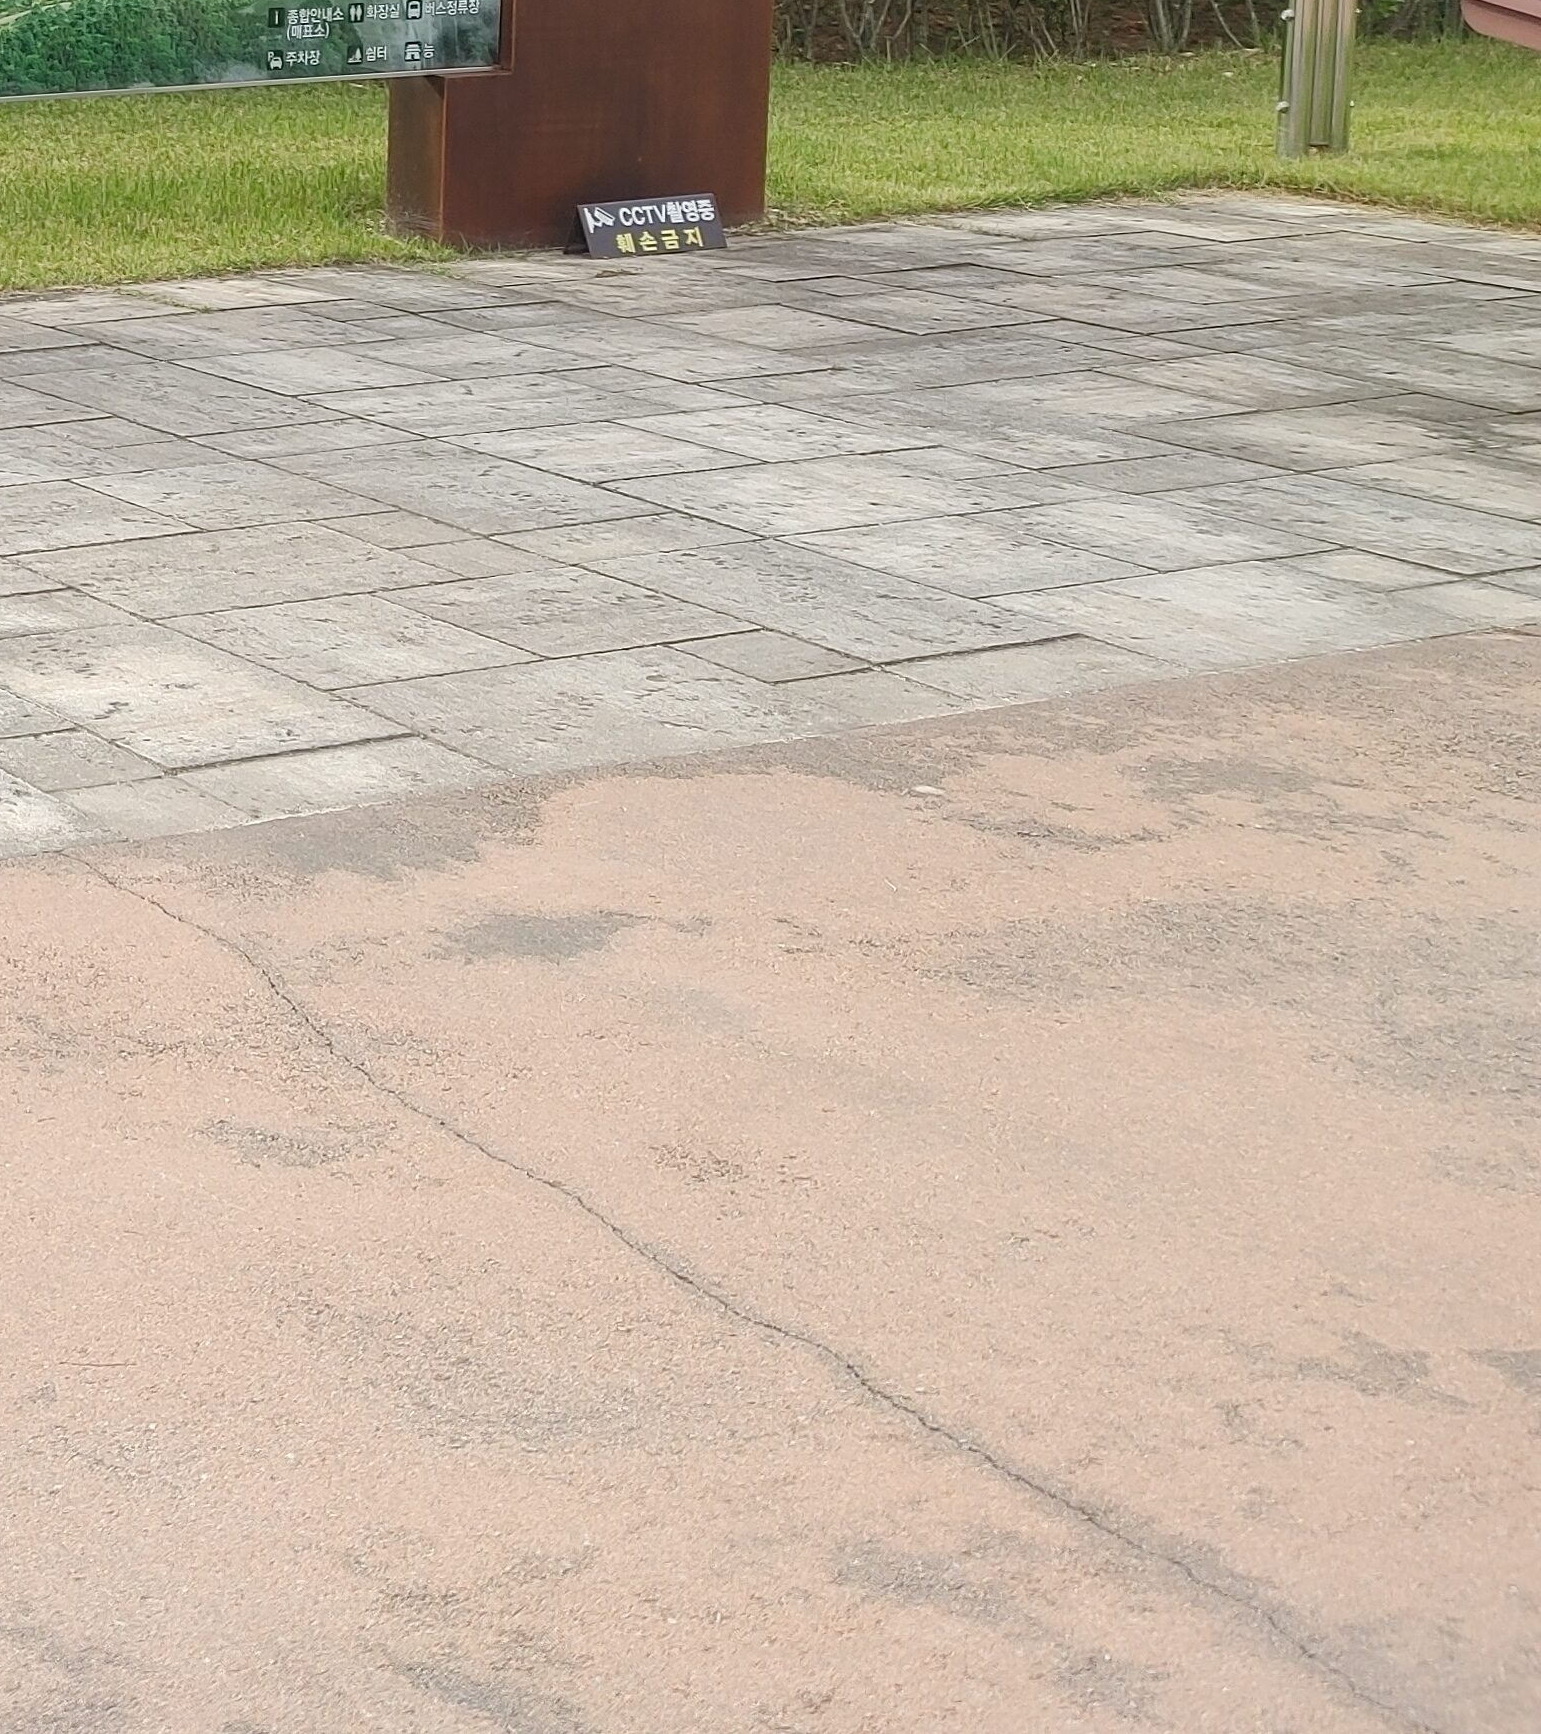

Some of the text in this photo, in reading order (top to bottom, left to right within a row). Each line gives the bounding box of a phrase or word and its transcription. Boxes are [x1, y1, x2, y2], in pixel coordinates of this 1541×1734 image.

[286, 9, 345, 24] 종합안내소
[366, 3, 400, 20] 화장실
[424, 0, 480, 16] 버스정류장
[286, 24, 330, 41] (매표소)
[285, 50, 321, 67] 주차장
[366, 46, 388, 62] 쉼터
[423, 44, 435, 59] 능
[619, 199, 716, 227] CCTV촬영중
[616, 226, 705, 254] 훼손금지
